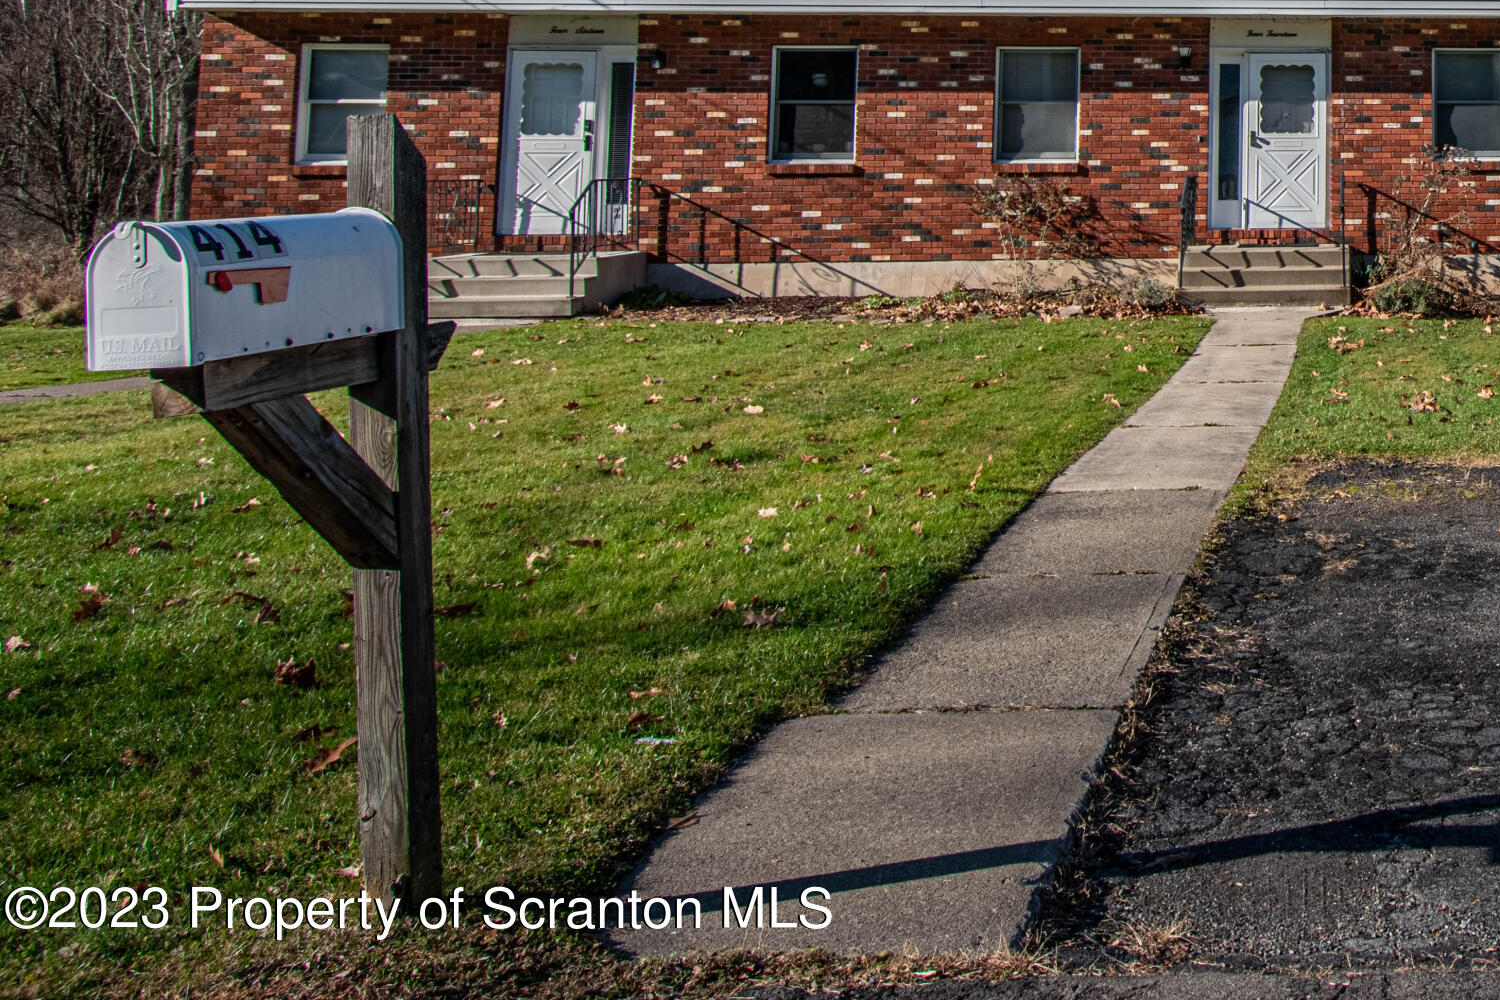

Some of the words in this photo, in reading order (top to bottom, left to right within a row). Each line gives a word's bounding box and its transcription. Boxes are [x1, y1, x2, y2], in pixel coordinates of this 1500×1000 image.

[186, 220, 283, 261] 414
[101, 338, 128, 355] U.S.
[131, 336, 181, 353] MAIL
